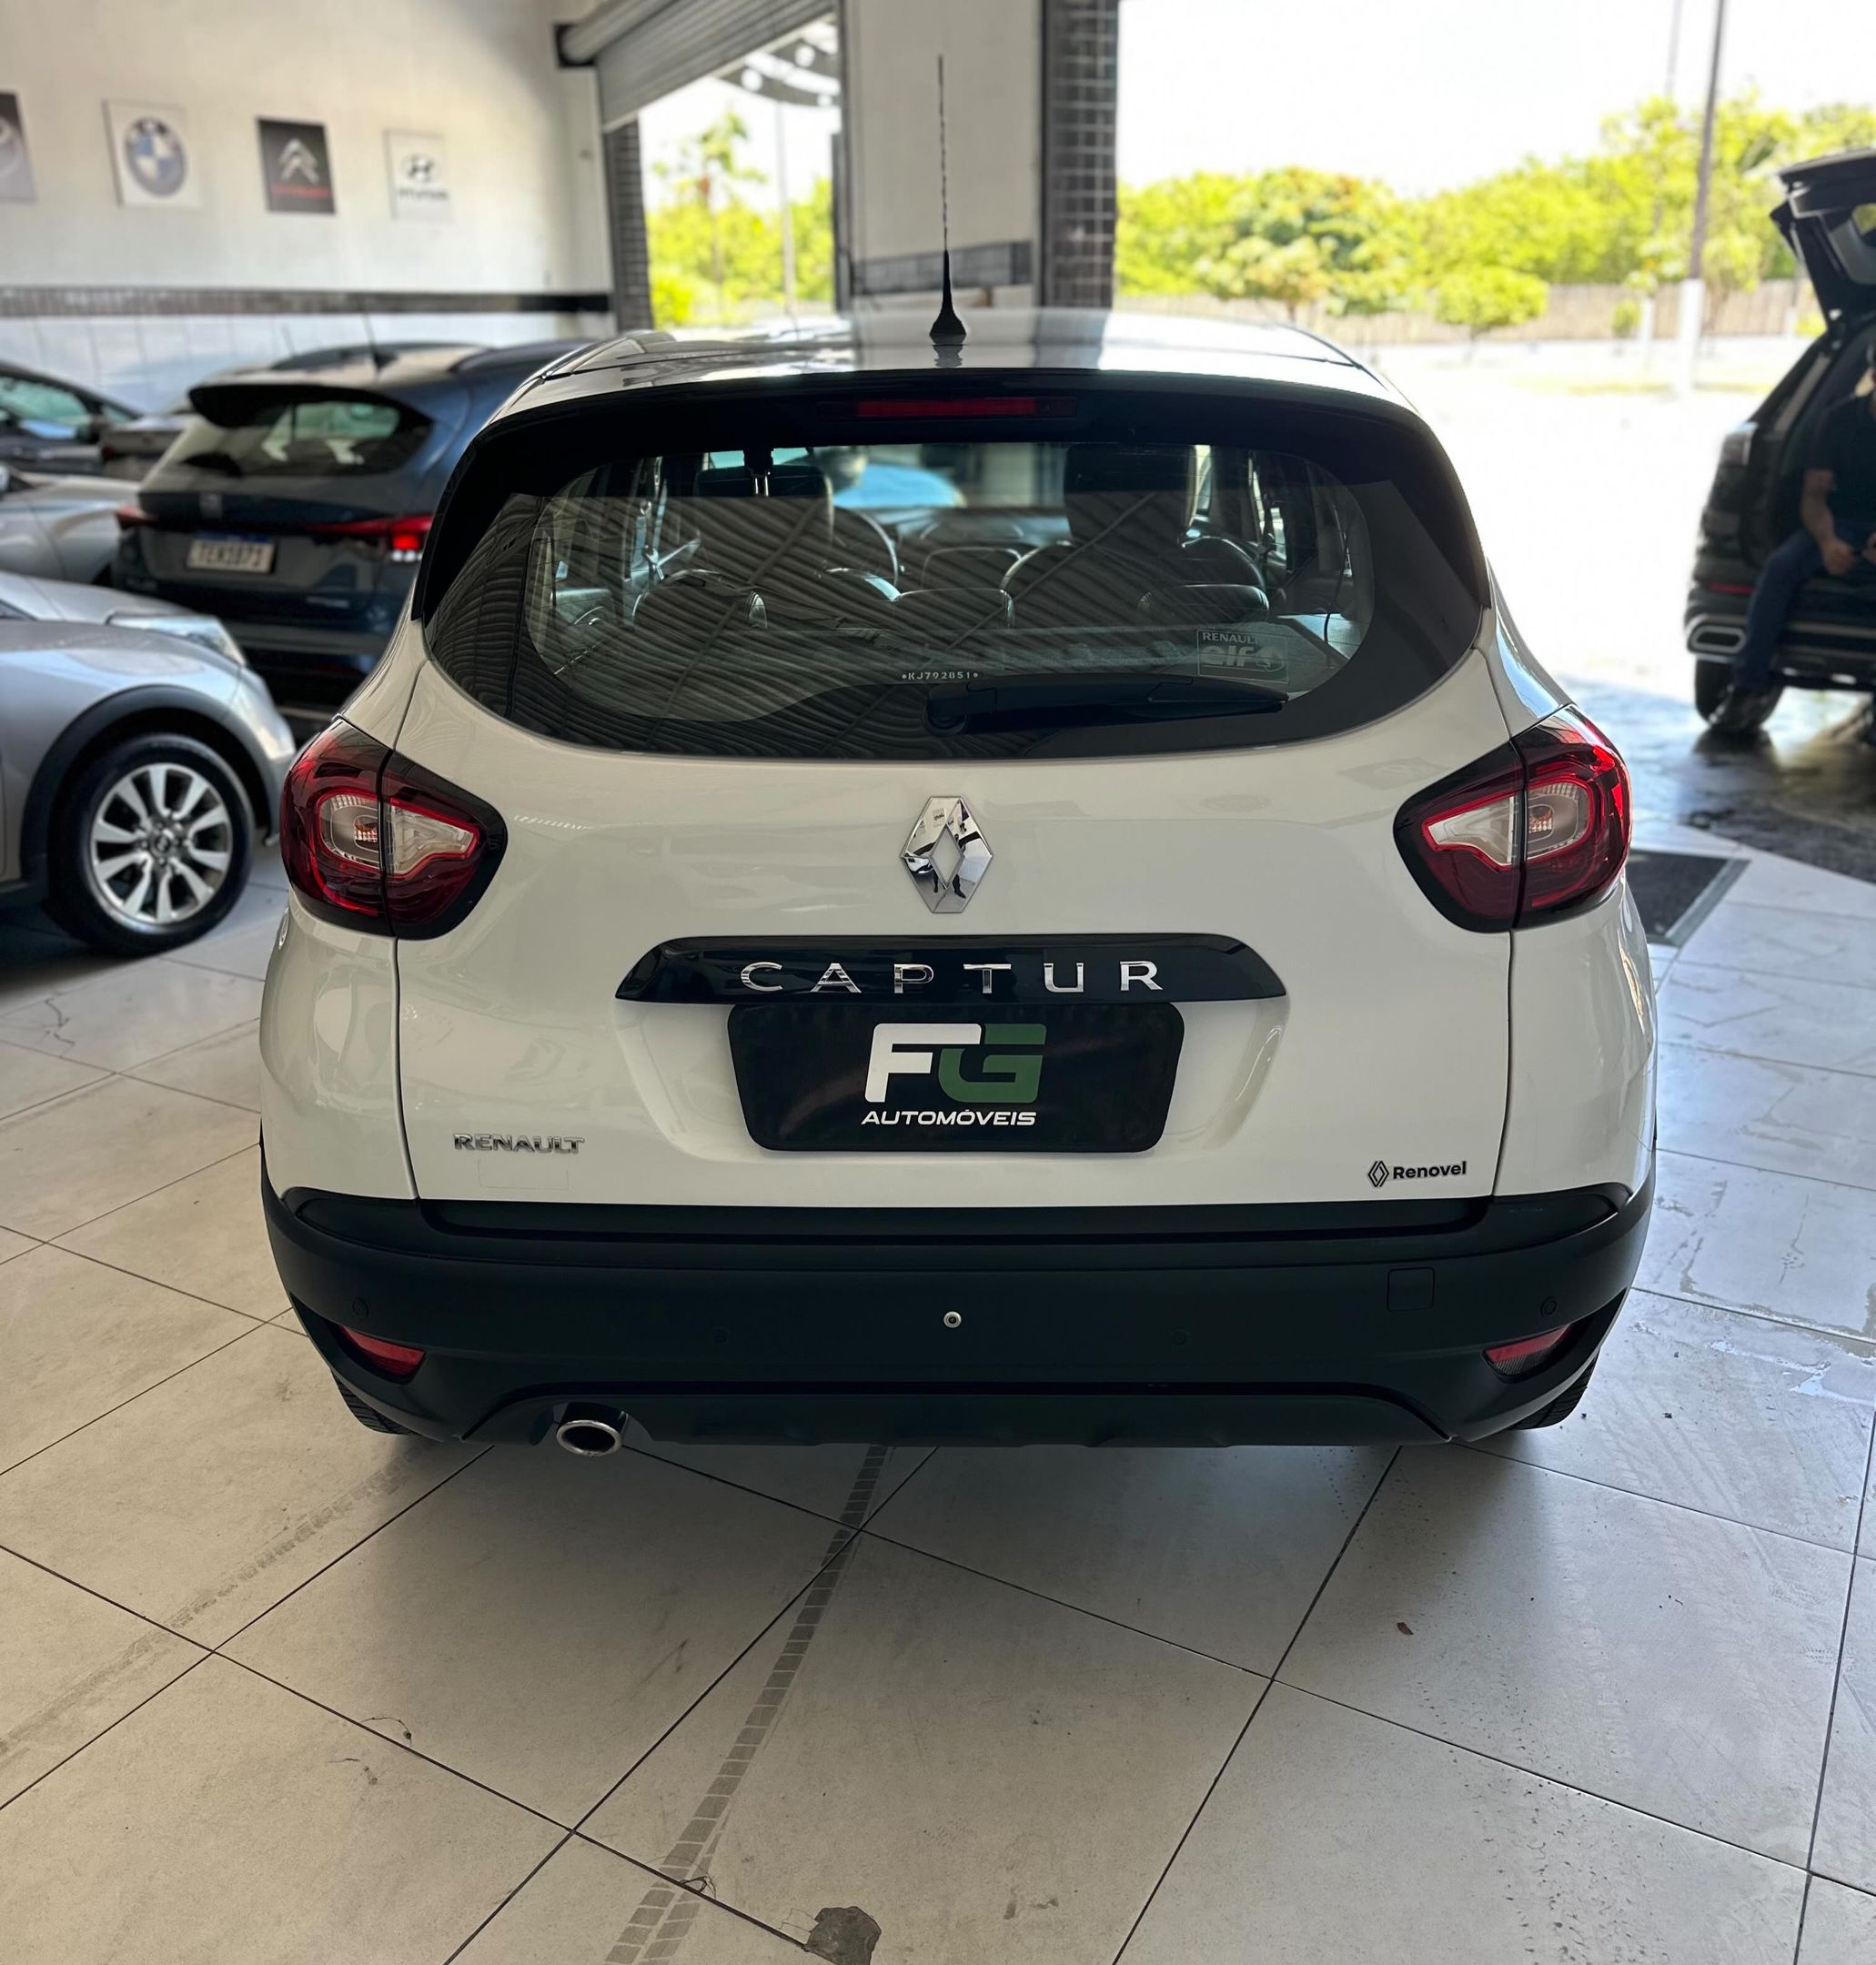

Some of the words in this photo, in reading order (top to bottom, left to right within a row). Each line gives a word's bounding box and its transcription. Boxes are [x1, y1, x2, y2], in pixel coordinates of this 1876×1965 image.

[1202, 631, 1266, 645] RENAUL
[740, 961, 1164, 993] CAPTUR
[864, 1023, 1047, 1103] FG
[861, 1109, 1037, 1126] AUTOMÓVEIS
[453, 1134, 585, 1154] RENAULT
[1393, 1161, 1467, 1180] Renovel
